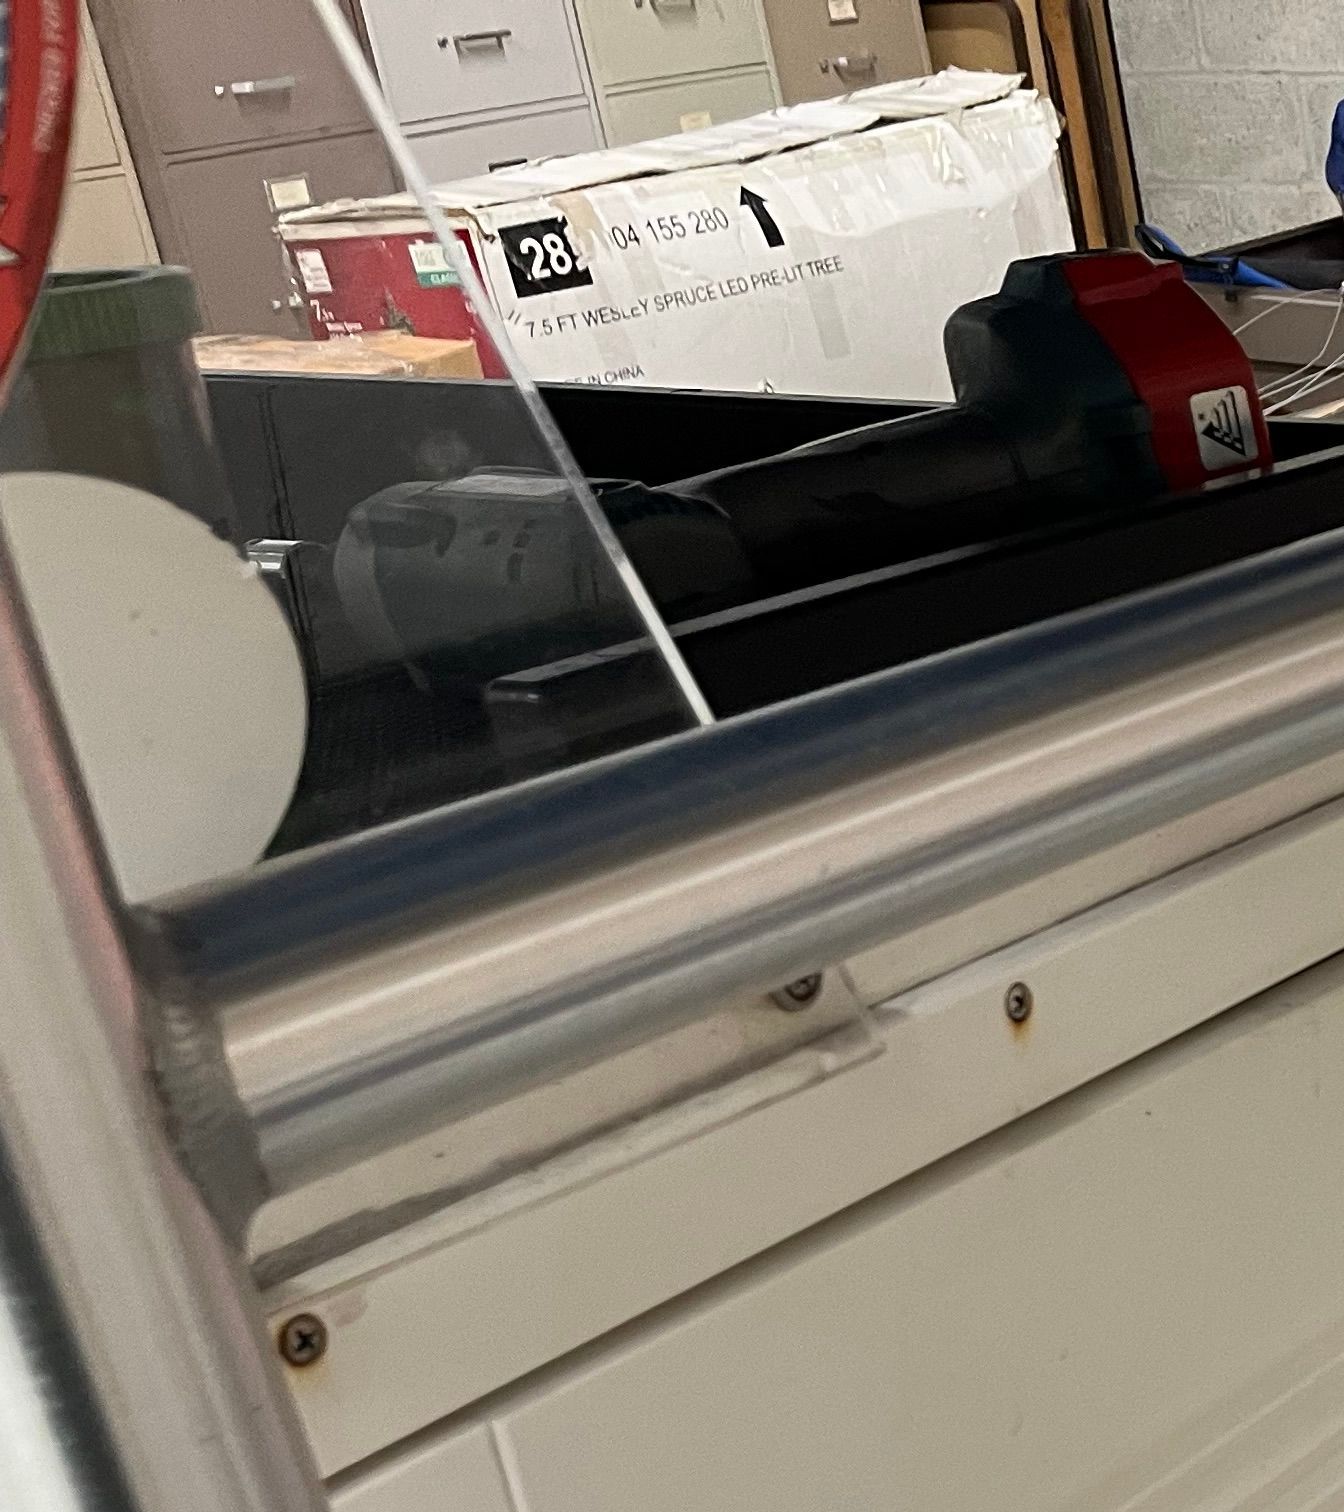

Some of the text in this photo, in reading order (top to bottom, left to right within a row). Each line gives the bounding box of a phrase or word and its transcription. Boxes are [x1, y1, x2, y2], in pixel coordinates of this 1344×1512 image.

[645, 215, 687, 244] 155
[687, 206, 729, 235] 280
[519, 232, 574, 281] 28
[525, 318, 553, 338] 7.5
[557, 312, 579, 333] FT
[653, 284, 718, 313] SPRUCE
[718, 274, 749, 298] LED
[750, 264, 806, 292] PRE-LIT
[810, 254, 845, 276] TREE
[604, 364, 645, 385] CHINA
